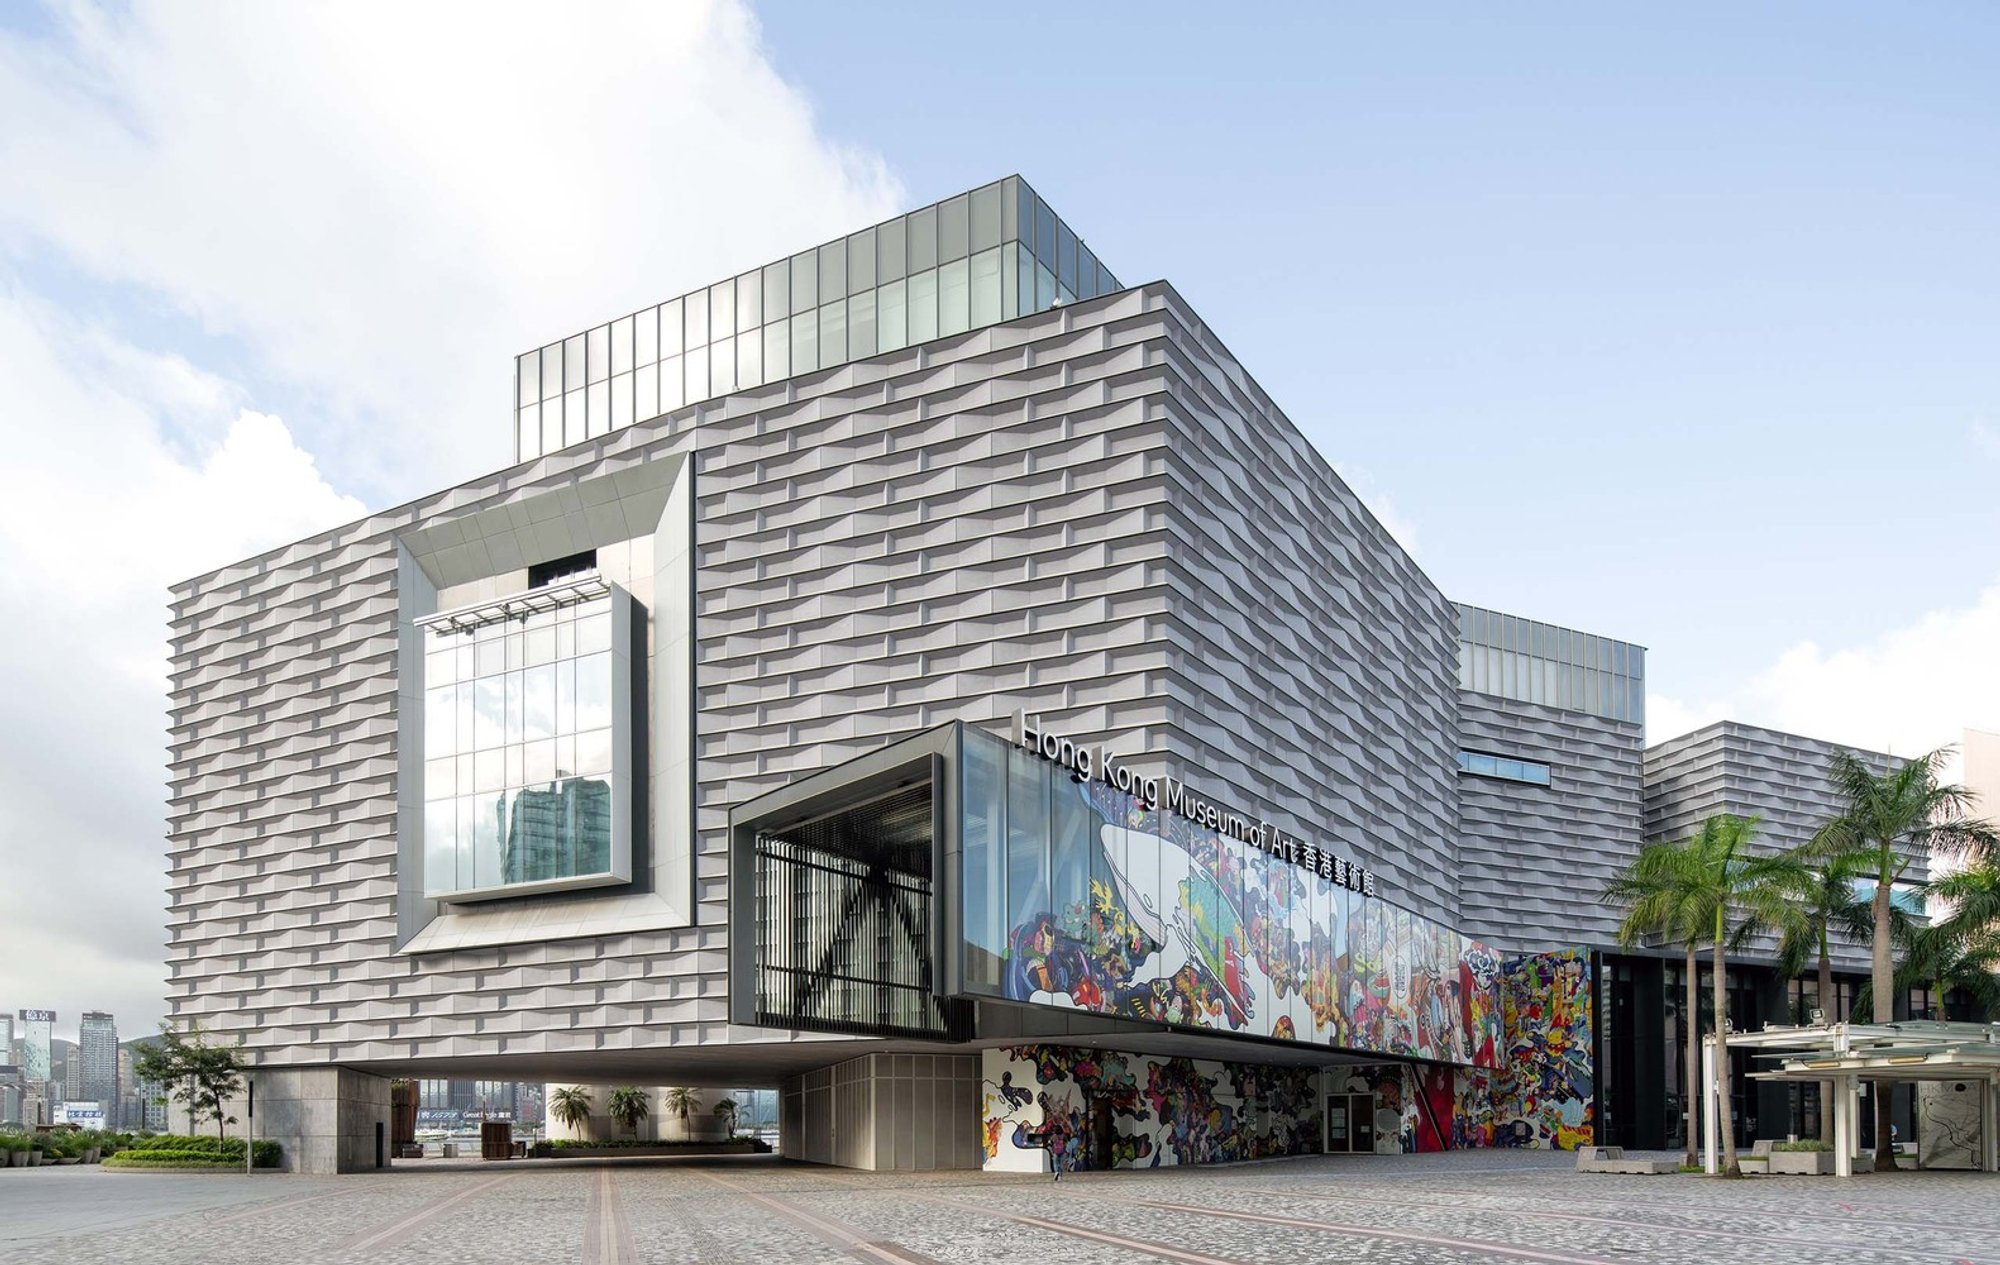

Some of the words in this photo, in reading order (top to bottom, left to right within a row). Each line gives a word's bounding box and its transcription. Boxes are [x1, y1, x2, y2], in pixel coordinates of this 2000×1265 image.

[1020, 707, 1093, 782] Hong
[1101, 745, 1158, 811] Kong
[1166, 776, 1245, 841] Museum
[1249, 820, 1268, 849] of
[1271, 827, 1299, 863] Art
[1303, 842, 1374, 897] 香港藝術館
